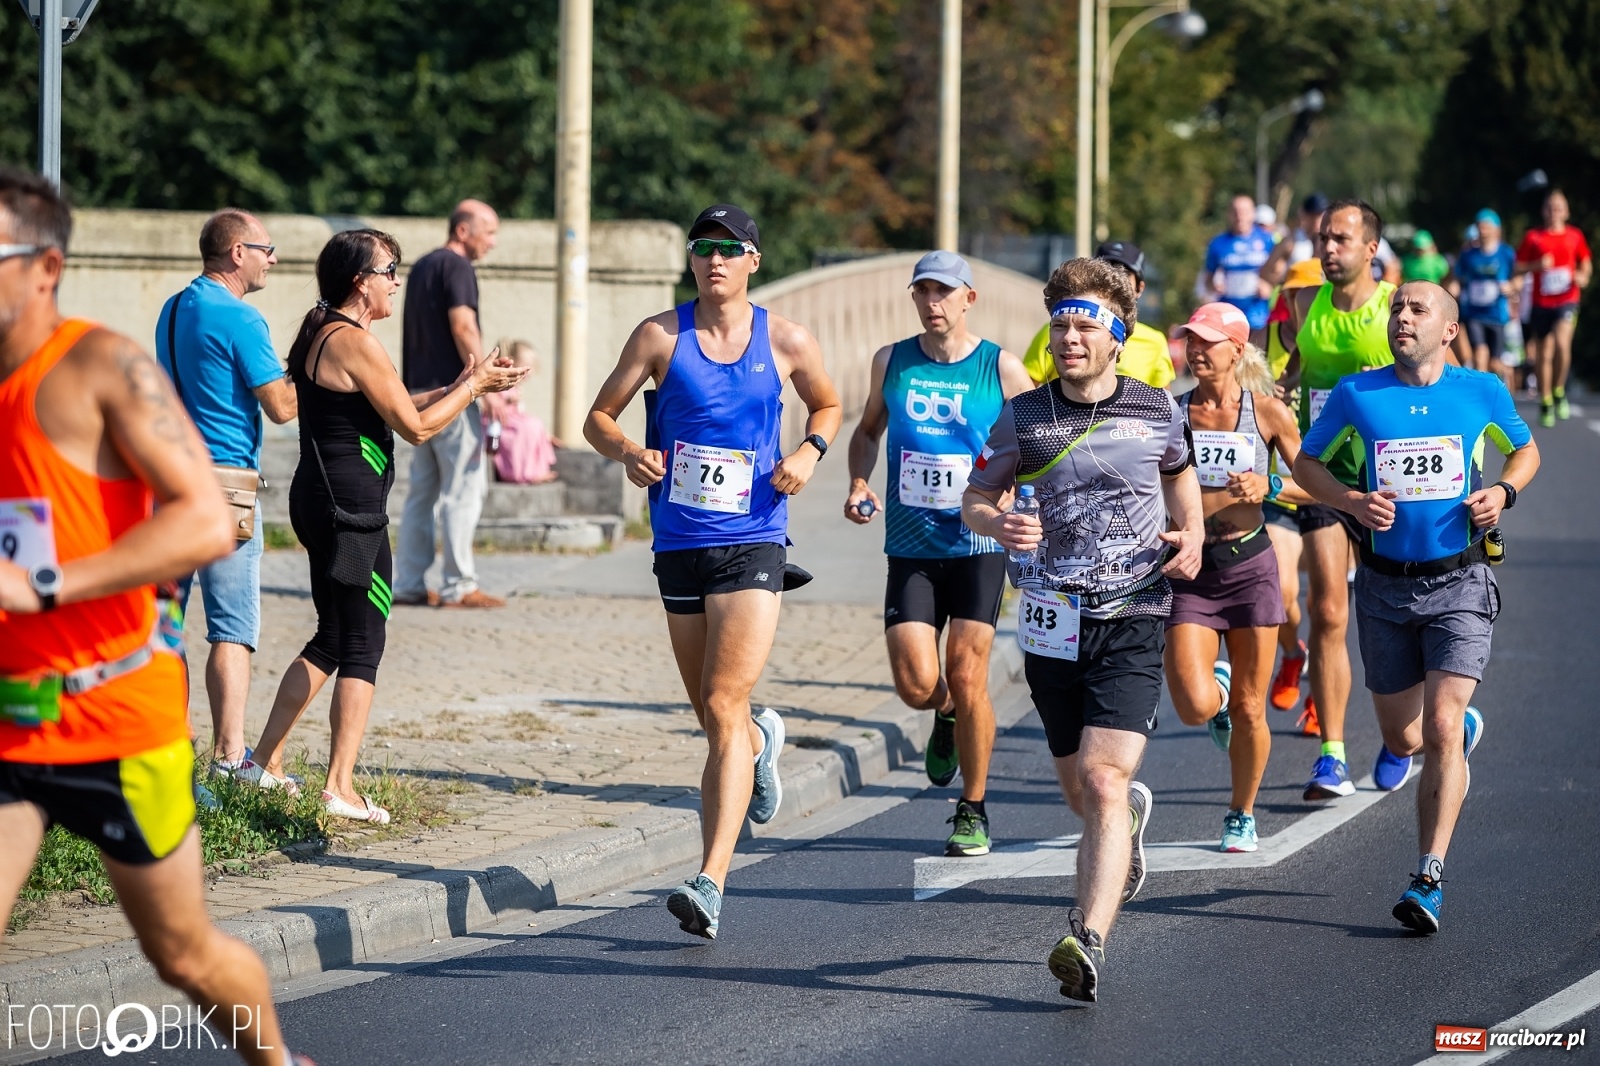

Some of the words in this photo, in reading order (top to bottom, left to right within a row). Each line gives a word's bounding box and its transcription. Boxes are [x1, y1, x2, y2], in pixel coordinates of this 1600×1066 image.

[906, 389, 967, 425] bbl
[1117, 420, 1146, 430] OLZA
[1200, 446, 1236, 466] 374
[1402, 454, 1443, 476] 238
[700, 464, 724, 485] 76
[922, 469, 952, 487] 131
[1025, 602, 1057, 630] 343
